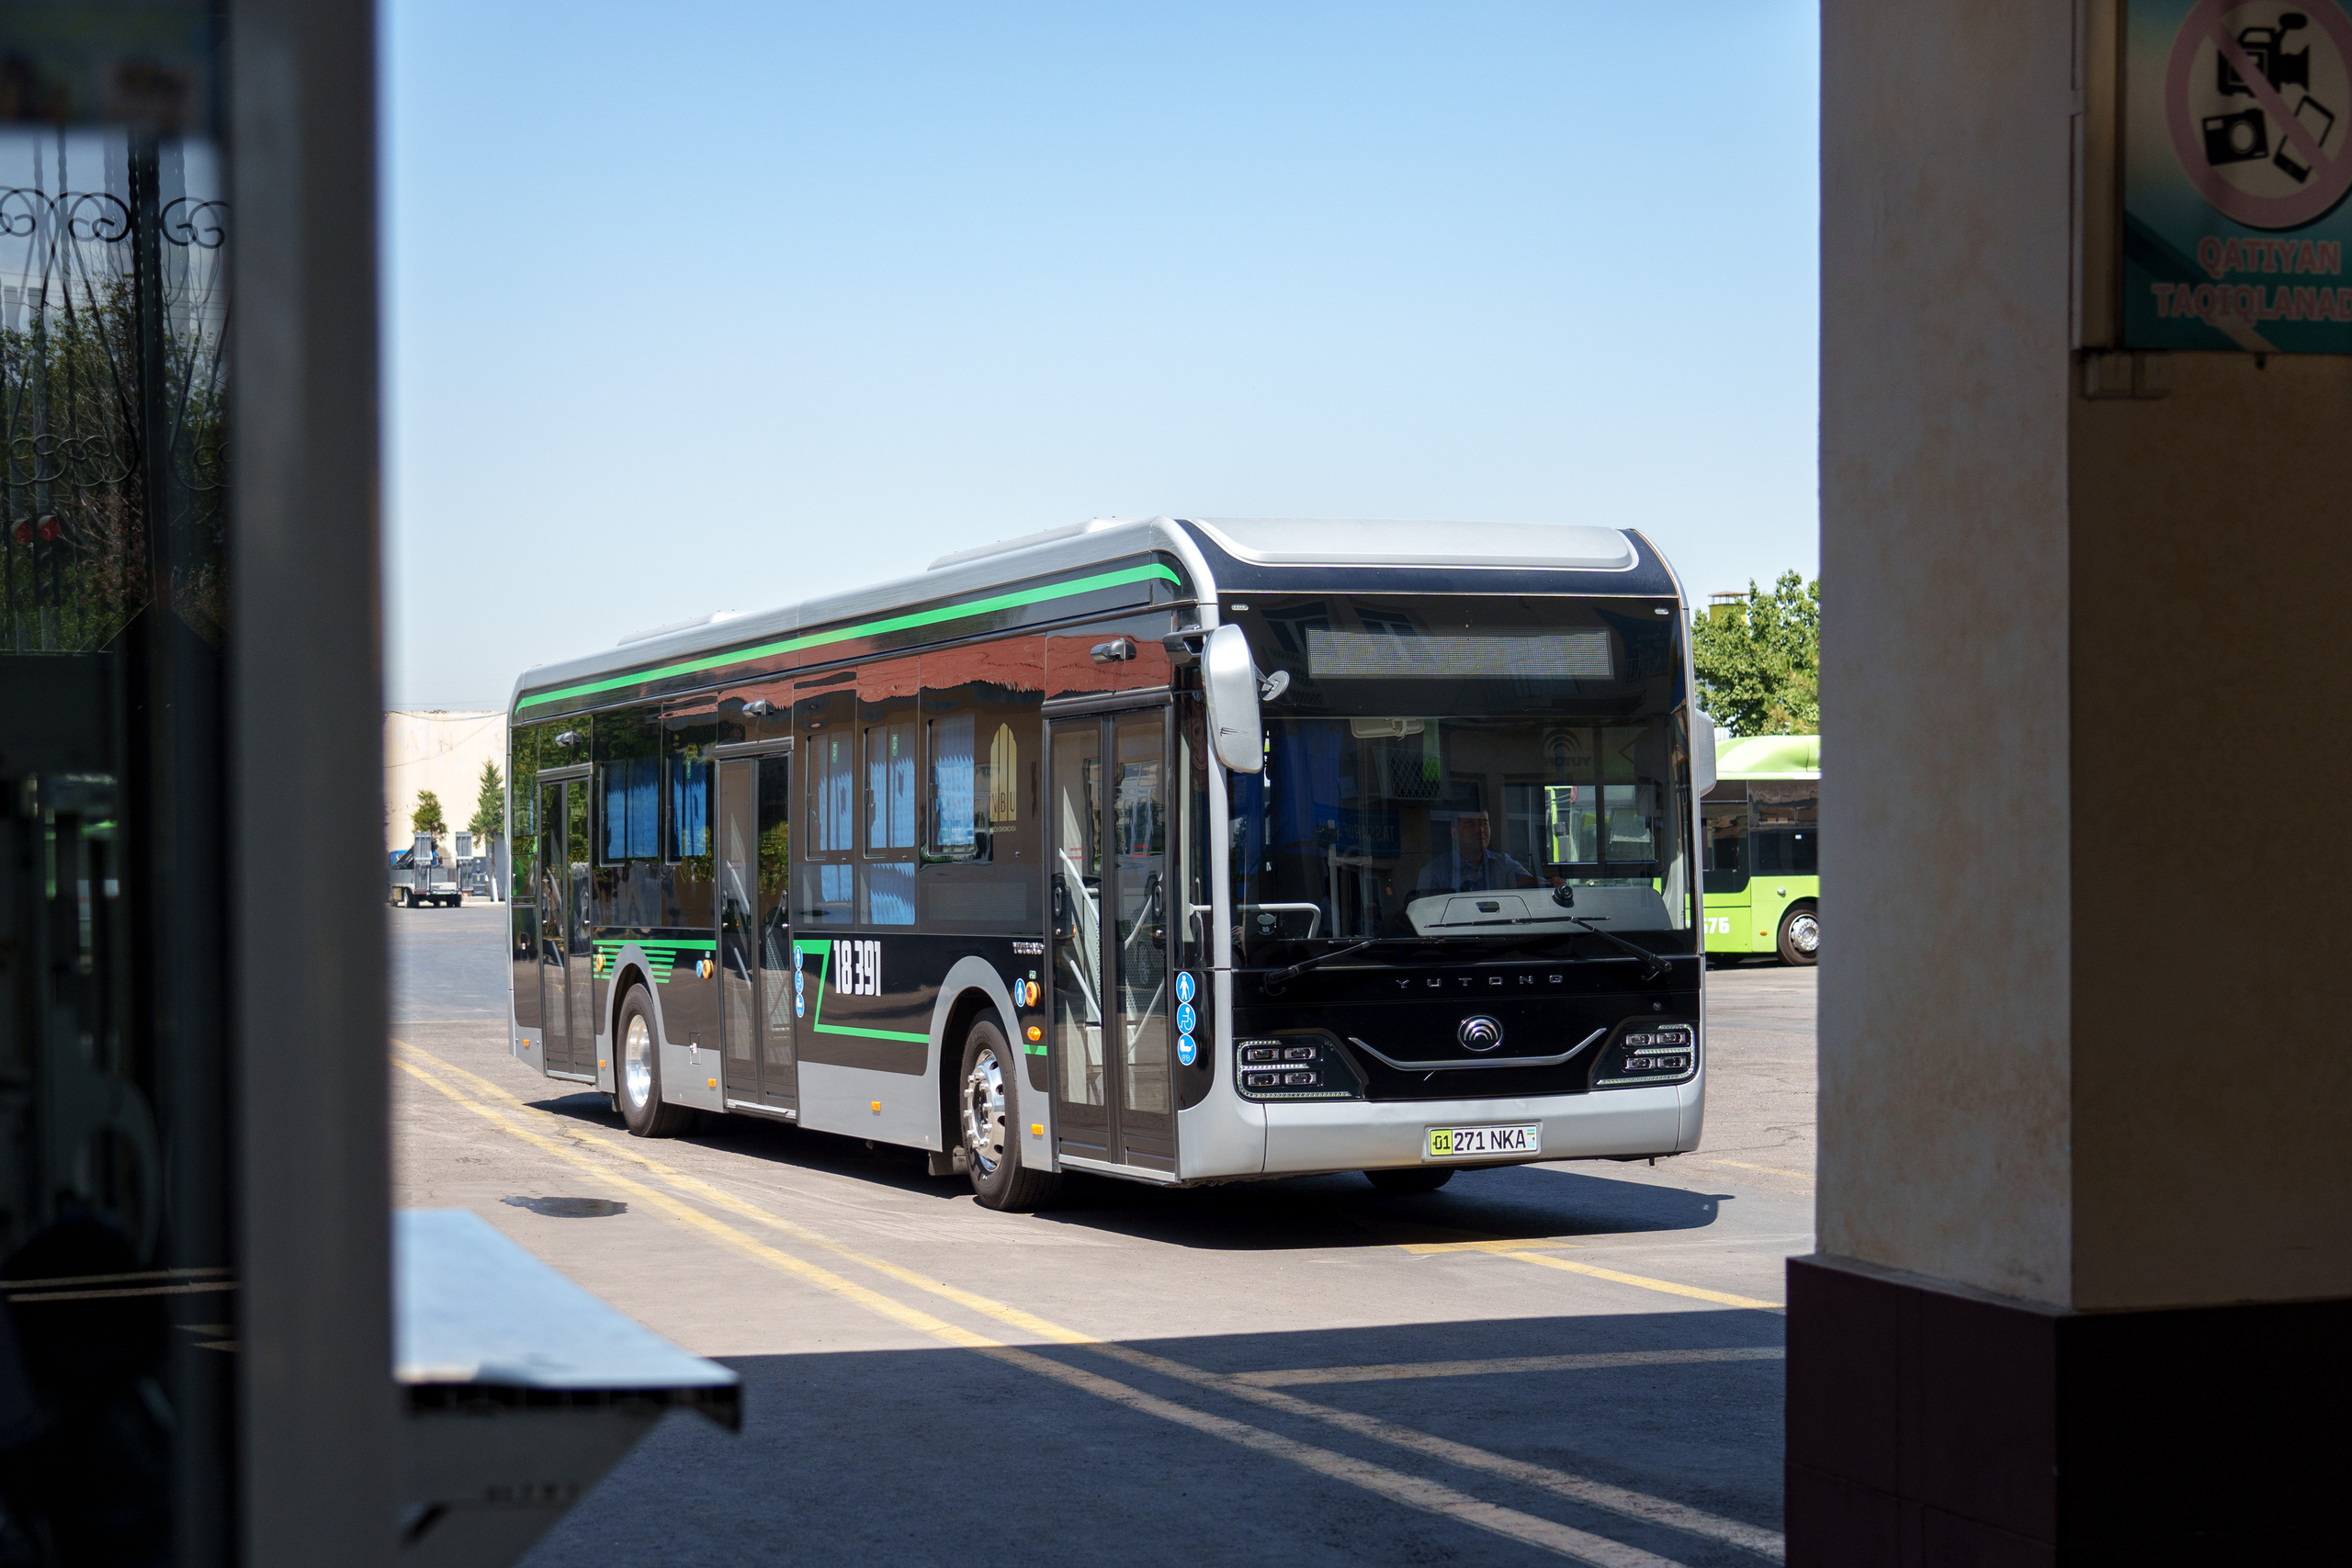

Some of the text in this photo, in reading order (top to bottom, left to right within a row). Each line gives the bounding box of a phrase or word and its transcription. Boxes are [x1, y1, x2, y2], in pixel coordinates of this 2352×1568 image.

[991, 791, 1015, 813] NBU
[1396, 974, 1564, 988] YUTONG
[1434, 1134, 1451, 1150] 01
[1454, 1131, 1486, 1152] 271
[1490, 1129, 1527, 1150] NKA
